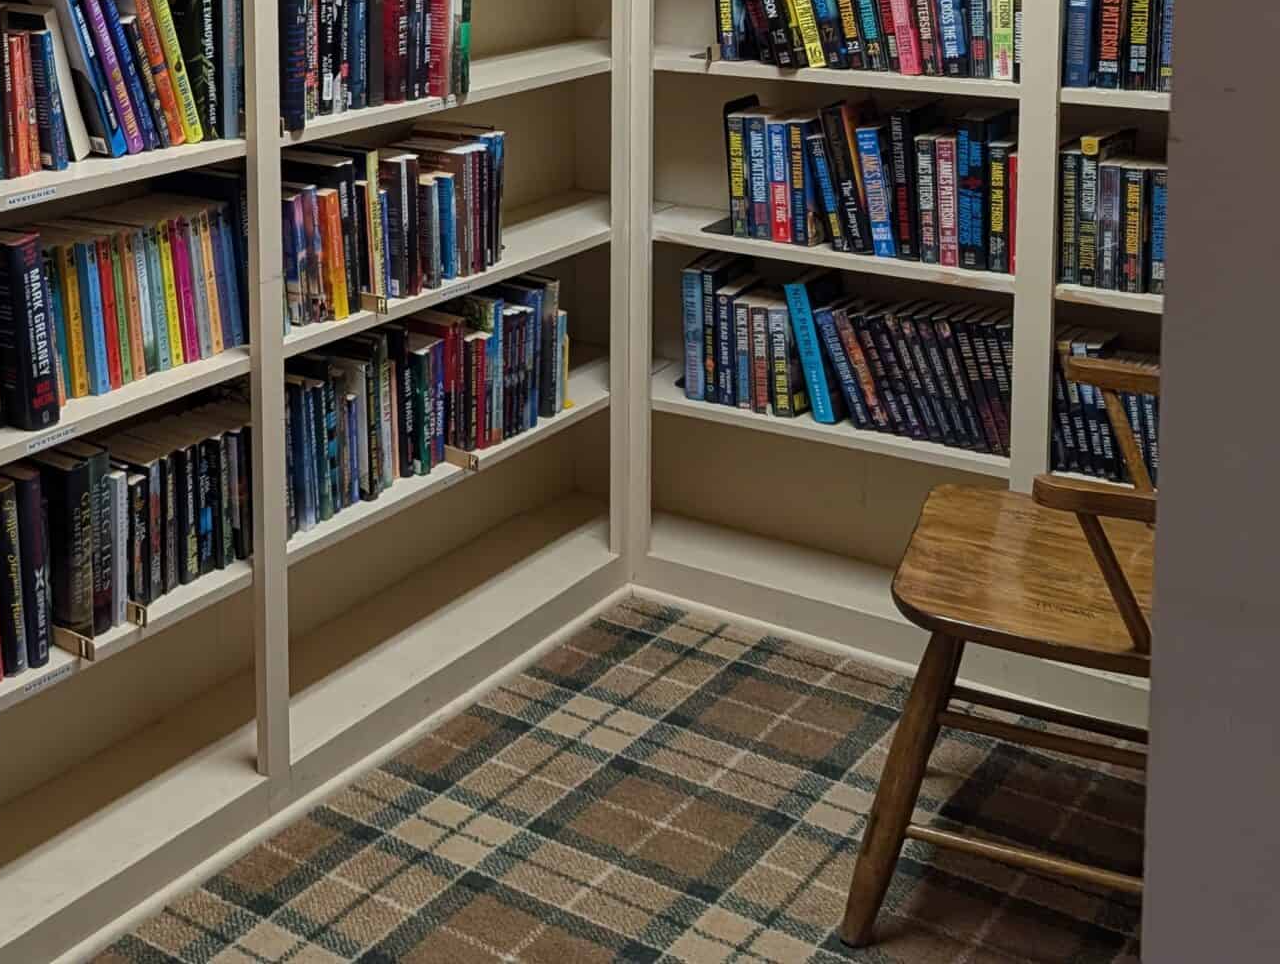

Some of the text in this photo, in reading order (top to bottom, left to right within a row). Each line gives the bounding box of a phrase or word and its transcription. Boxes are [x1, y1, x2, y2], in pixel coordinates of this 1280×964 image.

[202, 7, 214, 67] EVANOVICH
[941, 0, 959, 58] CROSS THE LINE
[8, 188, 56, 205] MYSTERIES
[940, 159, 954, 228] JAMES PATTERSON
[28, 268, 52, 376] MARK GREANEY
[770, 314, 785, 357] NICK PETRIE
